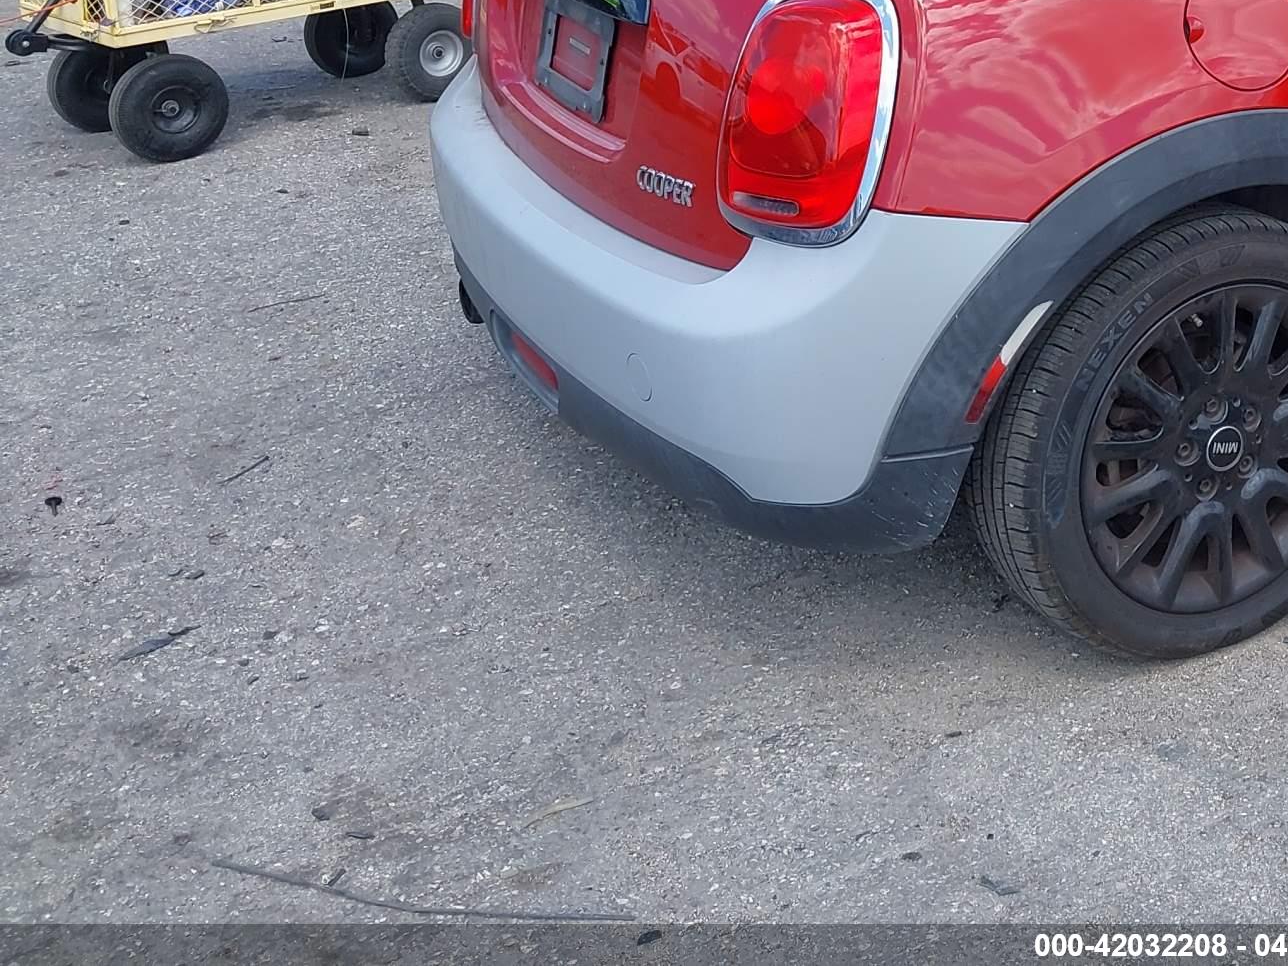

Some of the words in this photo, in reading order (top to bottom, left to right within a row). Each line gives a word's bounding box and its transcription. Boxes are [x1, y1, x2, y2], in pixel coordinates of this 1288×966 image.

[636, 165, 694, 208] COOPER
[1074, 292, 1153, 391] NEXEN
[1212, 441, 1239, 454] MINI
